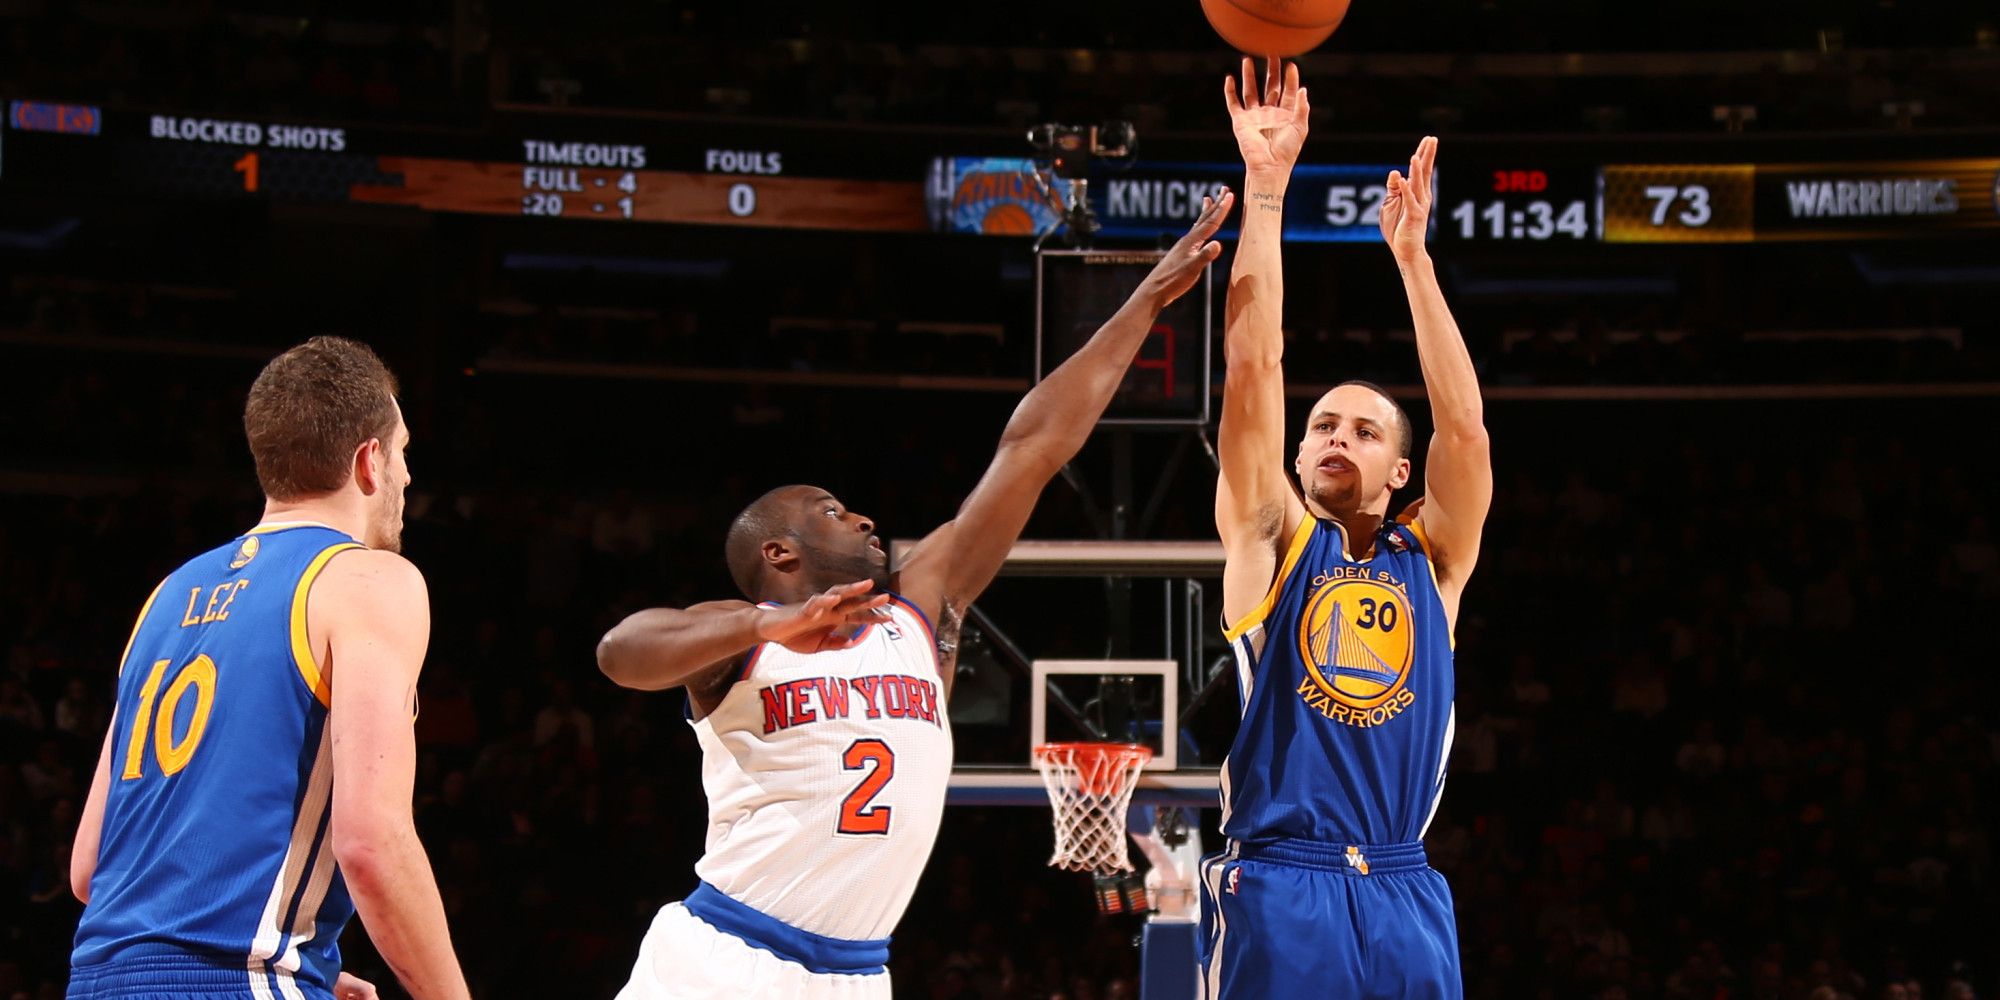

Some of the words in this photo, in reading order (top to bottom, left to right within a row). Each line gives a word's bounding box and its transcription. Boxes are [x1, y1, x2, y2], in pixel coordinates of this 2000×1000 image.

[150, 115, 262, 145] BLOCKED
[267, 124, 347, 152] SHOTS
[233, 151, 261, 193] 1
[523, 140, 647, 168] TIMEOUTS
[706, 150, 783, 174] FOULS
[523, 168, 584, 192] FULL
[617, 172, 637, 193] 4
[1493, 170, 1549, 192] 3RD
[1786, 179, 1960, 218] WARRIORS
[523, 193, 563, 216] :20
[618, 198, 634, 218] 1
[728, 184, 757, 217] 0
[1327, 185, 1388, 226] 52
[1451, 200, 1588, 239] 11:34
[1645, 185, 1712, 227] 73
[181, 579, 250, 627] LEE
[1356, 598, 1398, 633] 30
[122, 653, 217, 780] 10
[760, 676, 849, 735] NEW
[850, 674, 943, 730] YORK
[1296, 676, 1415, 728] WARRIORS
[836, 738, 896, 836] 2
